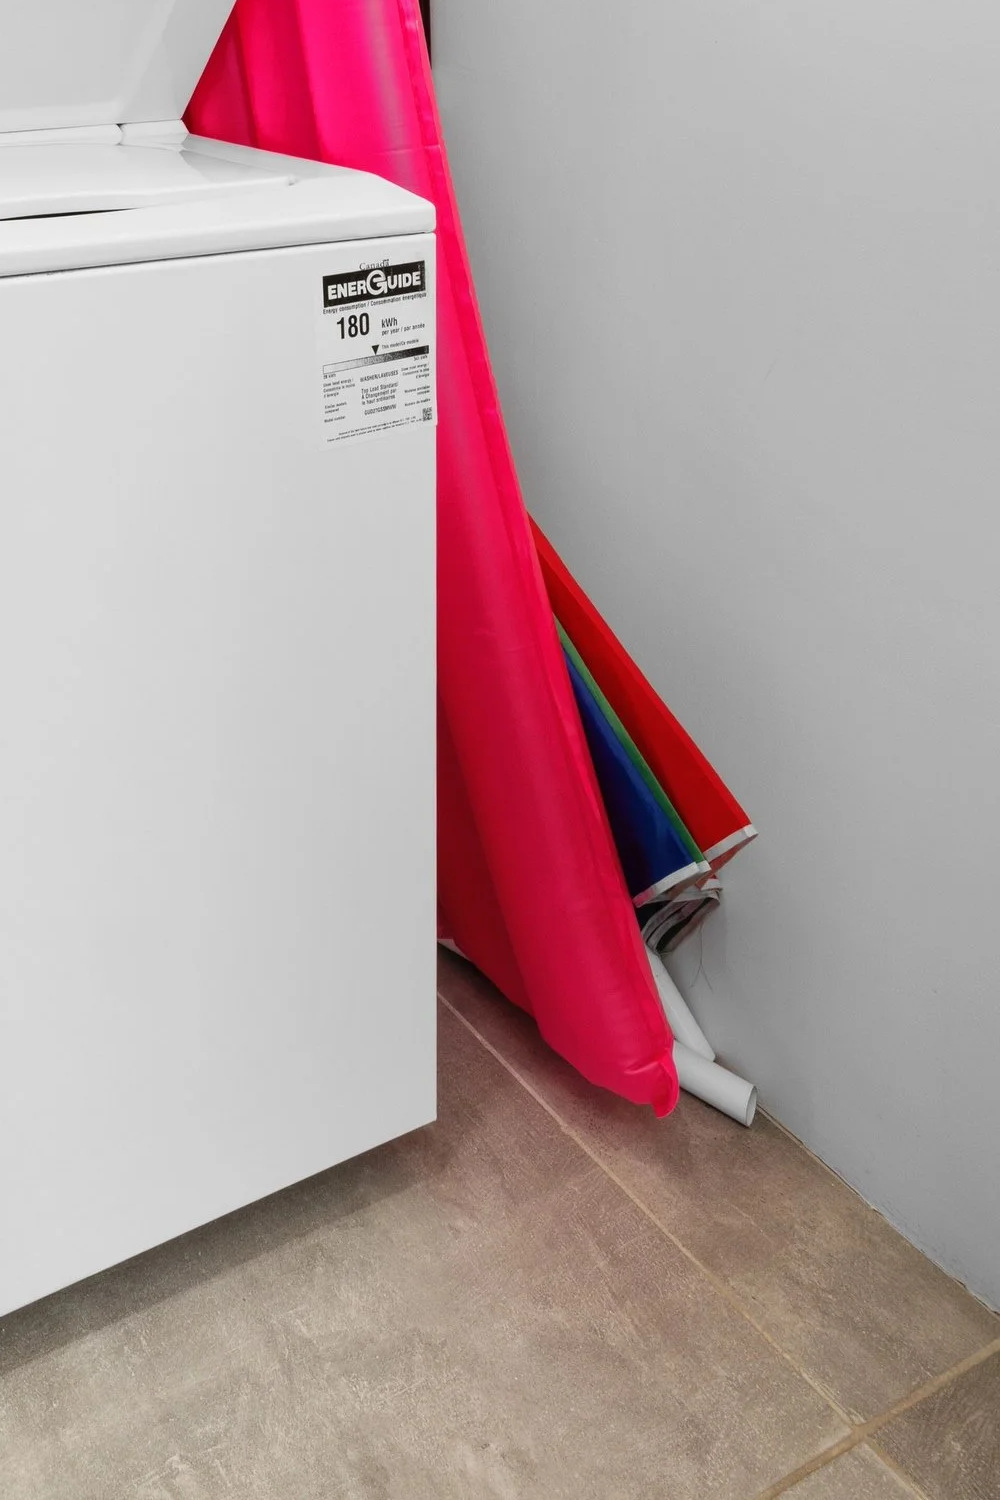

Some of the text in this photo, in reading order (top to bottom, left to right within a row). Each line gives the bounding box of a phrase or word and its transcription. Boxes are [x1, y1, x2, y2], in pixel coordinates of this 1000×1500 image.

[322, 307, 338, 315] Energy
[336, 312, 370, 340] 180
[381, 317, 398, 329] kWh
